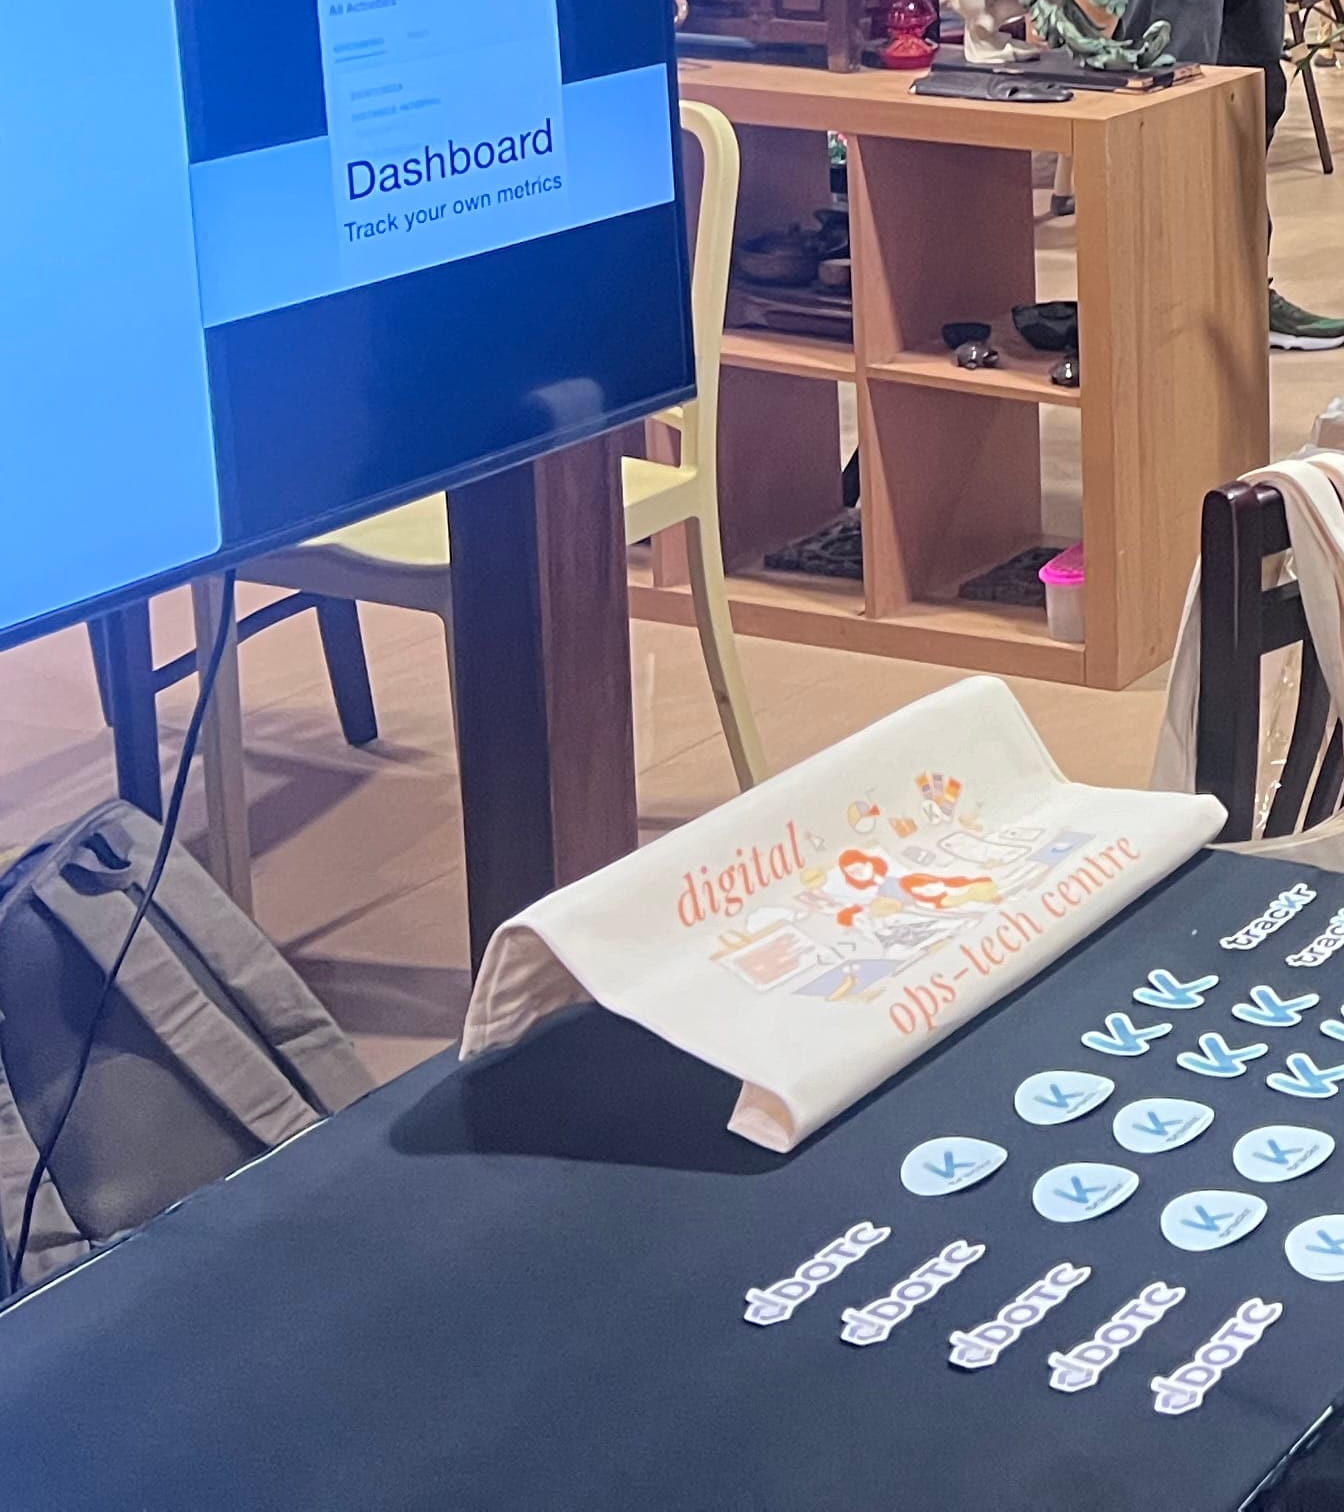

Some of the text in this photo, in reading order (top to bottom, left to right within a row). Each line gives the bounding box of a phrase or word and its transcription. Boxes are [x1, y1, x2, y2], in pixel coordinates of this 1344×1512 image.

[347, 117, 553, 201] Dashboard
[343, 173, 563, 243] Track your own metrics
[678, 819, 805, 928] digital
[889, 837, 1141, 1034] ops-tech centre
[771, 1226, 884, 1300] DOTC
[867, 1244, 979, 1320] DOTC
[974, 1268, 1085, 1346] DOTC
[1073, 1287, 1180, 1366] DOTC
[1177, 1303, 1278, 1387] DOTC
